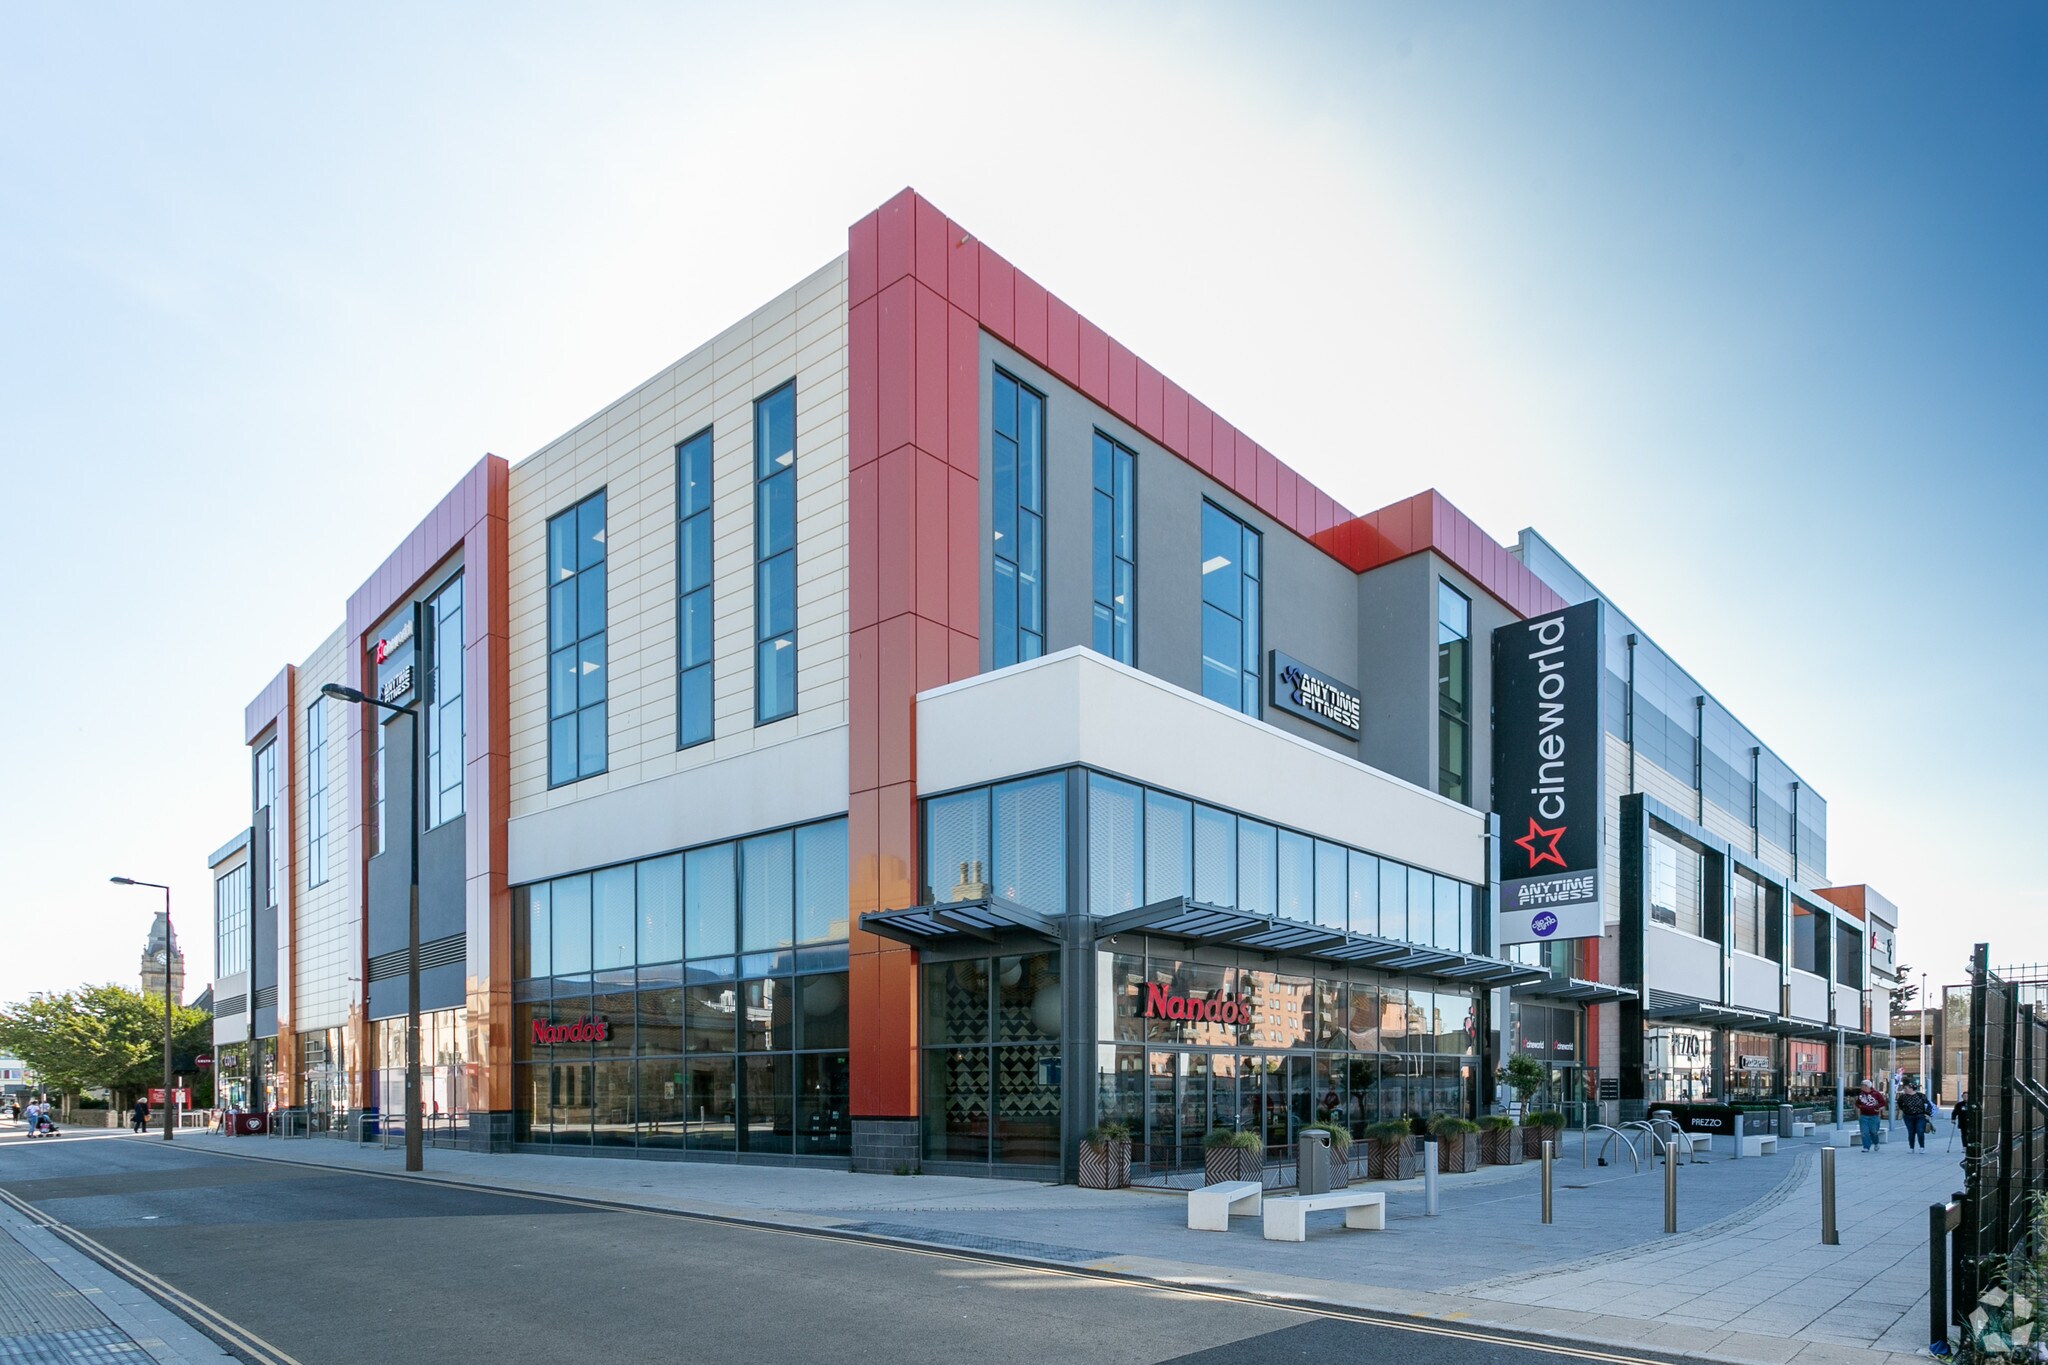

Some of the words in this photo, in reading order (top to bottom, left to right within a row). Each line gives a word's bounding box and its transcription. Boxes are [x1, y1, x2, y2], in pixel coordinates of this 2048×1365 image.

[384, 665, 411, 695] ANYTIME
[384, 678, 411, 704] FITNESS
[1301, 673, 1360, 716] ANYTIME
[1302, 692, 1360, 730] FITNESS
[1528, 616, 1566, 820] cineworld
[1518, 876, 1594, 897] ANYTIME
[1519, 888, 1594, 906] FITNESS
[1144, 981, 1251, 1025] Nando's
[531, 1015, 606, 1045] Nando's
[1526, 1040, 1545, 1049] cineworld
[1556, 1042, 1574, 1051] cineworld
[1691, 1117, 1722, 1127] PREZZO
